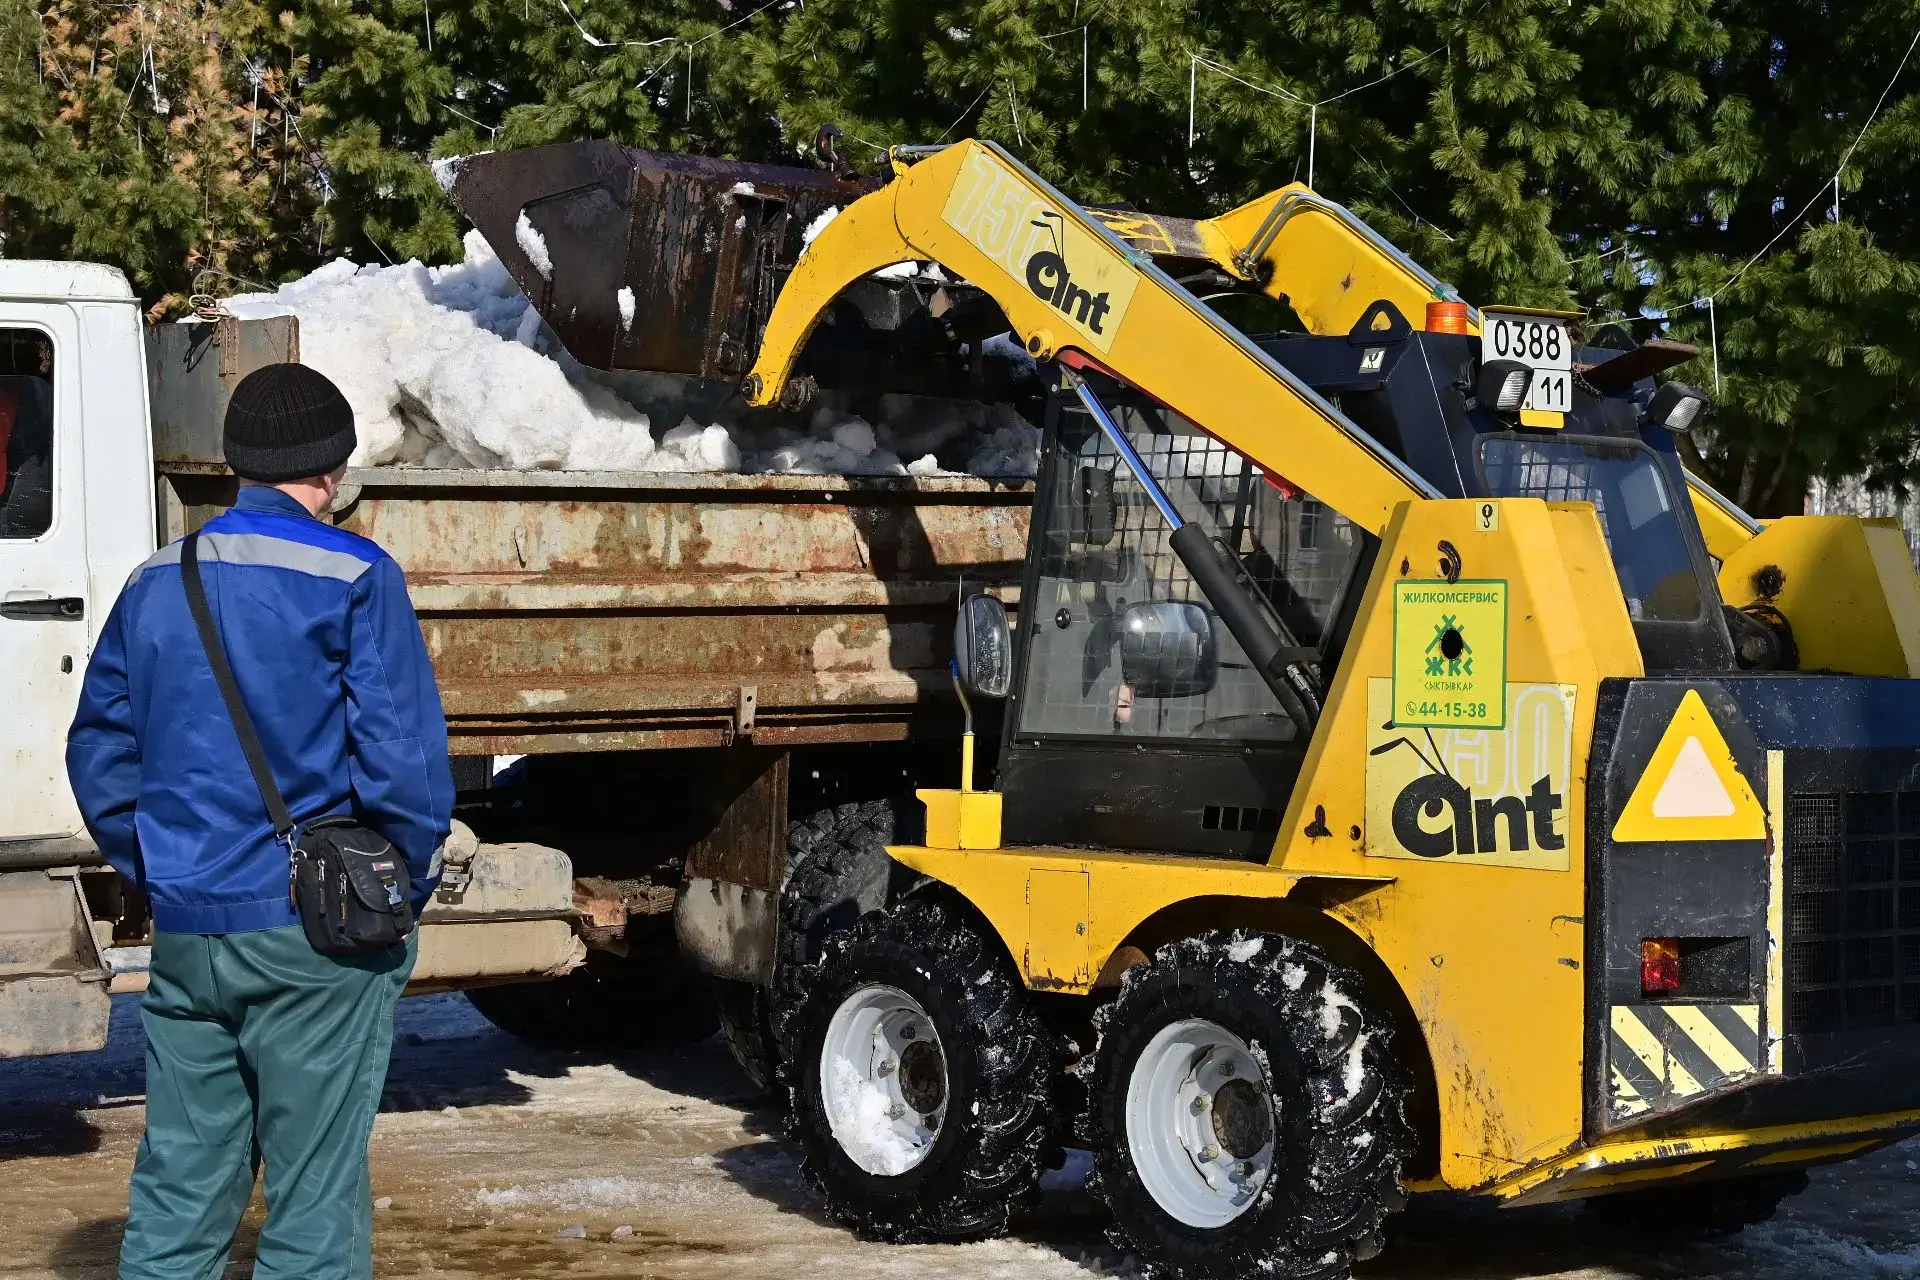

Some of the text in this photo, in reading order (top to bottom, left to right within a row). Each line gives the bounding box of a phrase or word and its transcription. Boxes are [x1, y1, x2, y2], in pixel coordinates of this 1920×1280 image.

[952, 151, 1057, 284] 750
[1026, 250, 1111, 336] ant
[1494, 319, 1561, 361] 0388
[1540, 376, 1564, 406] 11
[1402, 591, 1499, 604] ЖИЛКОМСЕРВИС
[1424, 655, 1474, 677] ЖКС
[1424, 680, 1474, 692] СЫКТЫВКАР
[1418, 701, 1487, 719] 44-15-38
[1391, 773, 1566, 858] ant
